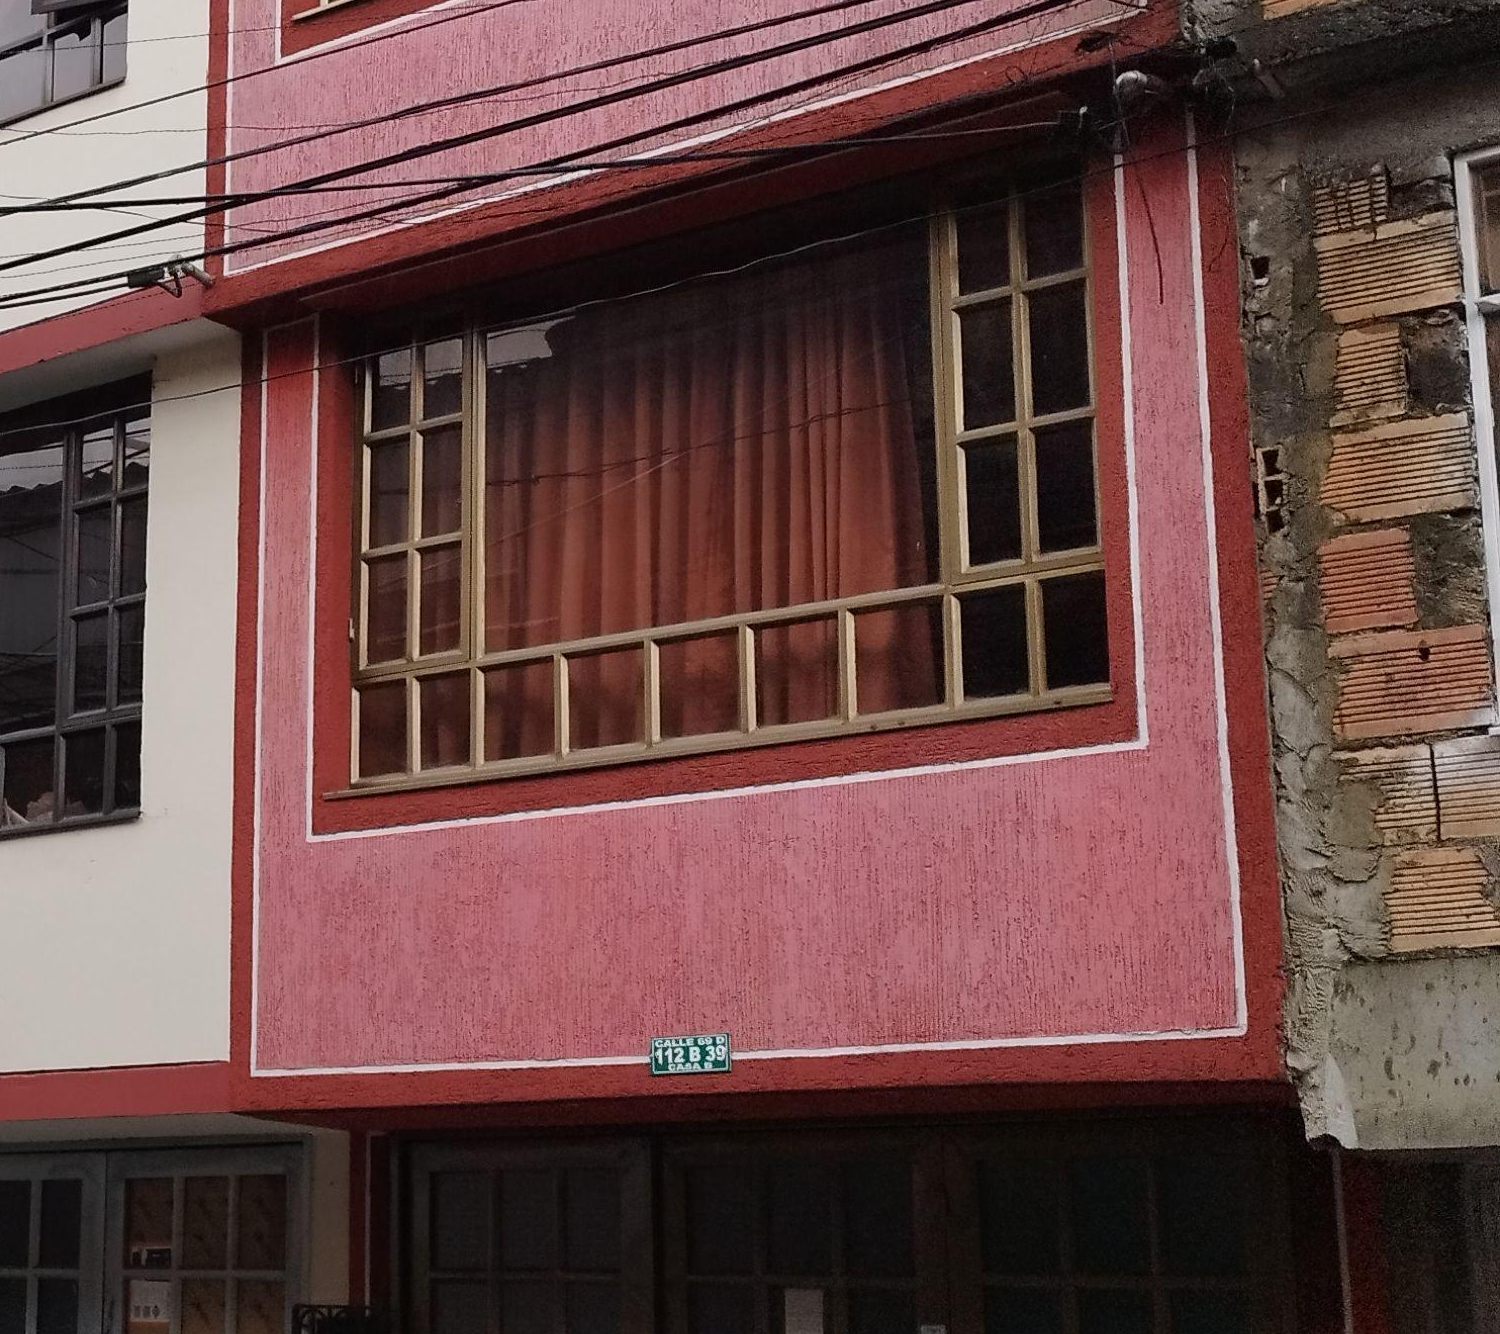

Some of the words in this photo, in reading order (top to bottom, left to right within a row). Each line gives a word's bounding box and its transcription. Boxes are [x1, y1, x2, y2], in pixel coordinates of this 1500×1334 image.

[655, 1038, 695, 1048] CALLE
[716, 1036, 725, 1044] D
[655, 1046, 685, 1065] 112
[689, 1046, 701, 1062] B
[705, 1044, 727, 1062] 39
[668, 1062, 701, 1071] CASA
